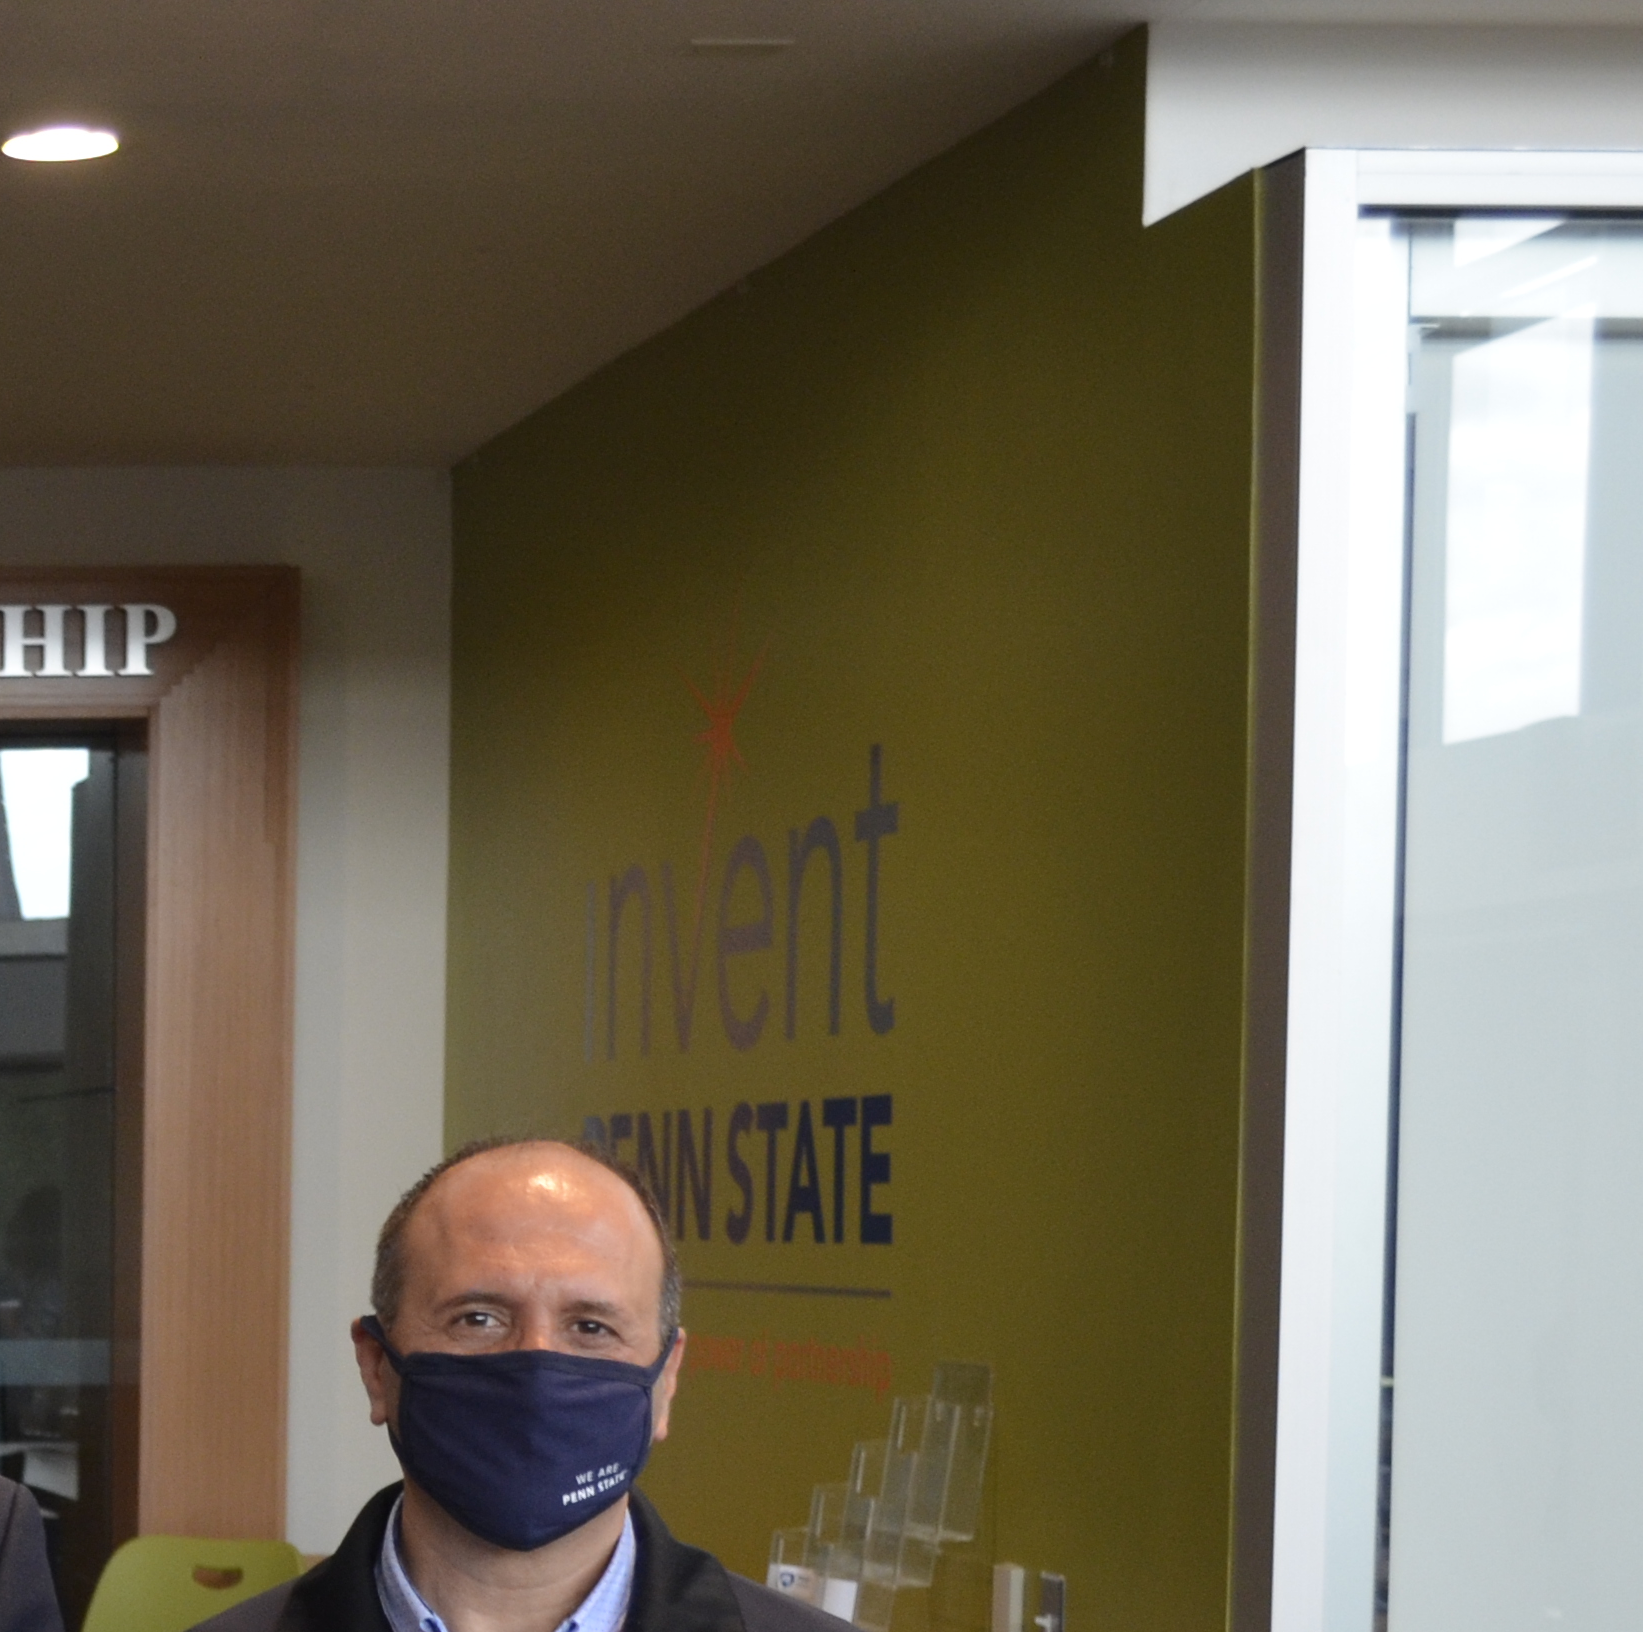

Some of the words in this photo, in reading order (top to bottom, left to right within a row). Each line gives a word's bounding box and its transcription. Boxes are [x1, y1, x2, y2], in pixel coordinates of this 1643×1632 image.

[584, 743, 899, 1064] invent
[583, 1108, 711, 1241] NN
[726, 1094, 893, 1245] STATE
[562, 1485, 596, 1506] PENN
[597, 1471, 626, 1493] STATE
[575, 1470, 593, 1485] WE
[597, 1462, 619, 1478] ARE
